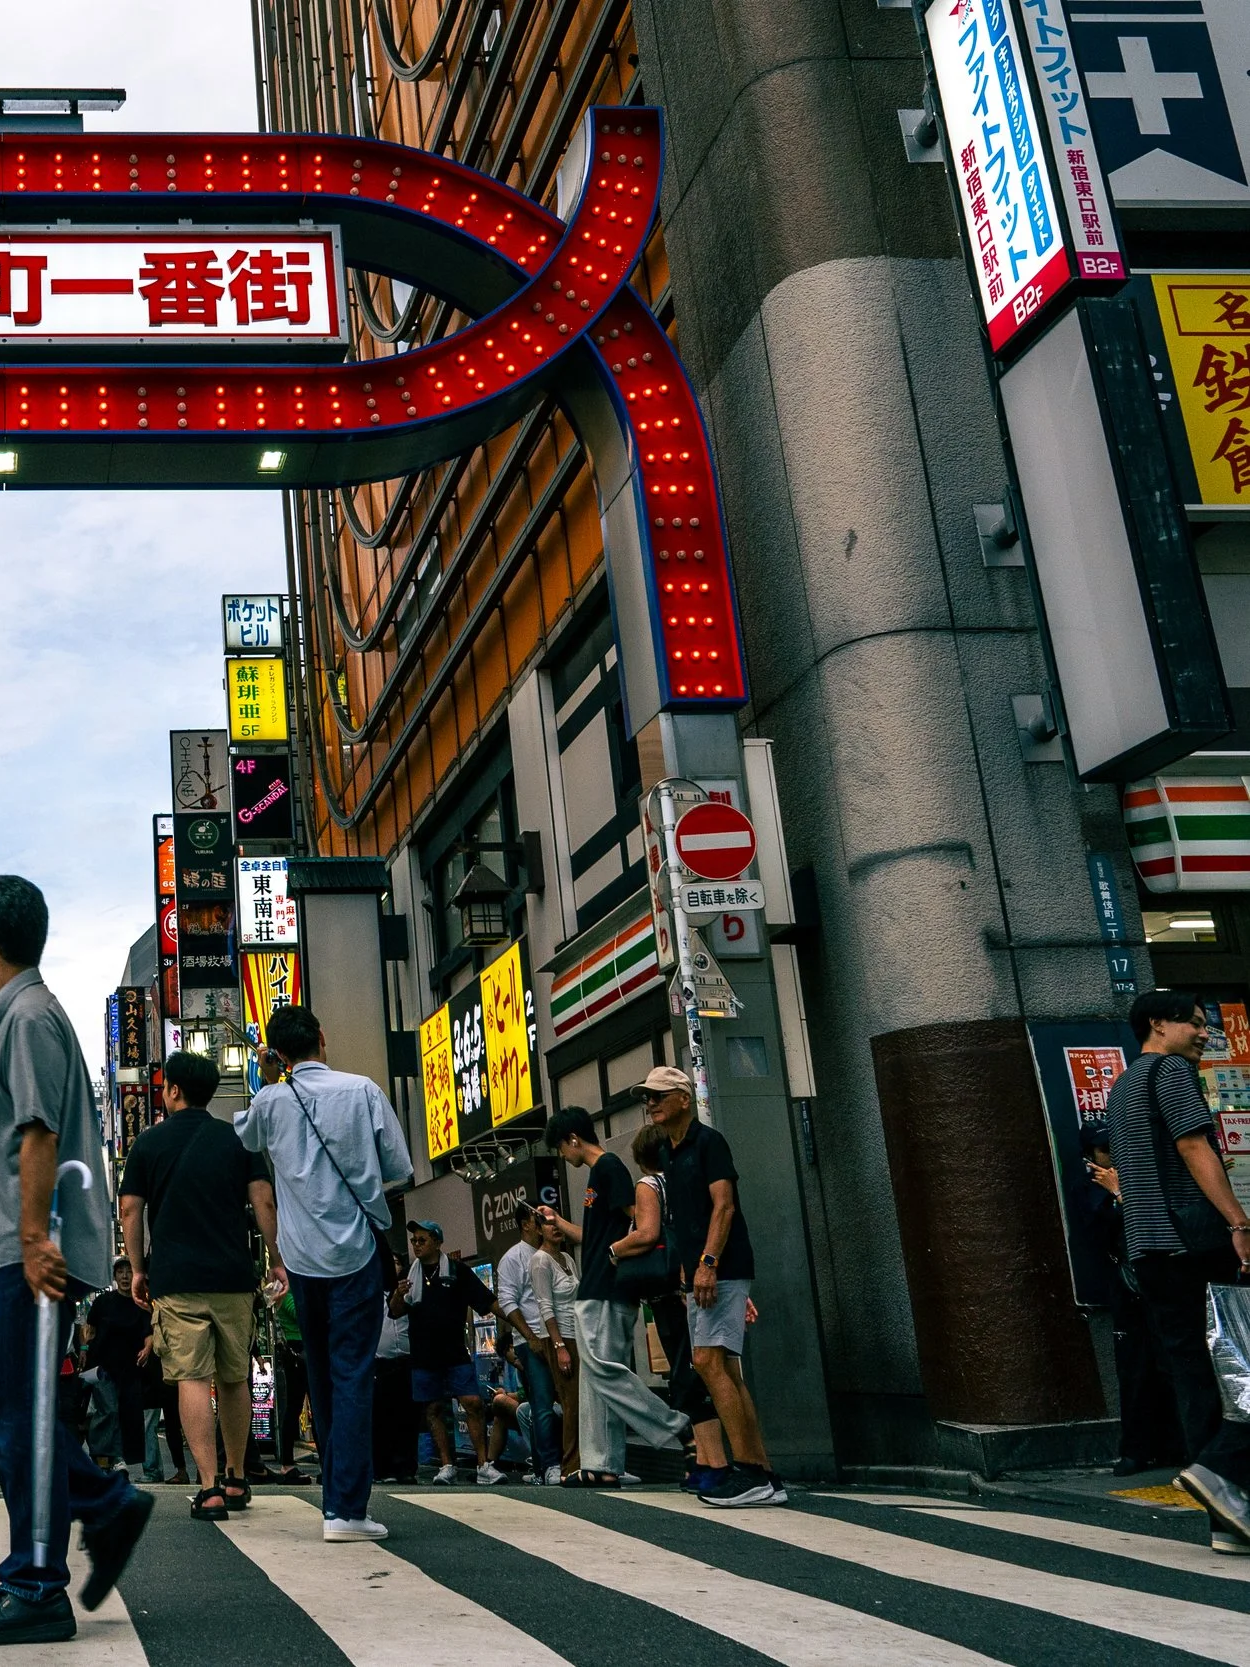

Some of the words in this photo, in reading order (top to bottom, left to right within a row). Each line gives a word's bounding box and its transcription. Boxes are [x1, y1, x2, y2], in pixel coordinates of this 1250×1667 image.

[998, 46, 1029, 164] キックボクシング
[958, 19, 1027, 282] ファイトフィット
[1026, 171, 1049, 248] ダイエット
[1067, 150, 1103, 245] 新宿東口駅前
[961, 140, 1005, 305] 新宿東口駅前
[1083, 258, 1118, 274] B2F
[1013, 283, 1043, 326] B2F
[227, 598, 278, 622] ポケット
[240, 624, 269, 647] ビル
[241, 725, 260, 736] 5F
[236, 760, 255, 773] 4F
[252, 875, 274, 941] 東南荘
[275, 895, 285, 934] 専門店
[667, 887, 758, 907] 自転車を除く
[1098, 881, 1121, 947] 歌舞伎町一丁
[1112, 958, 1128, 972] 17
[1116, 983, 1135, 991] 17-2
[493, 958, 521, 1033] ビール
[500, 1047, 529, 1115] サワー
[430, 1099, 453, 1155] 餃子
